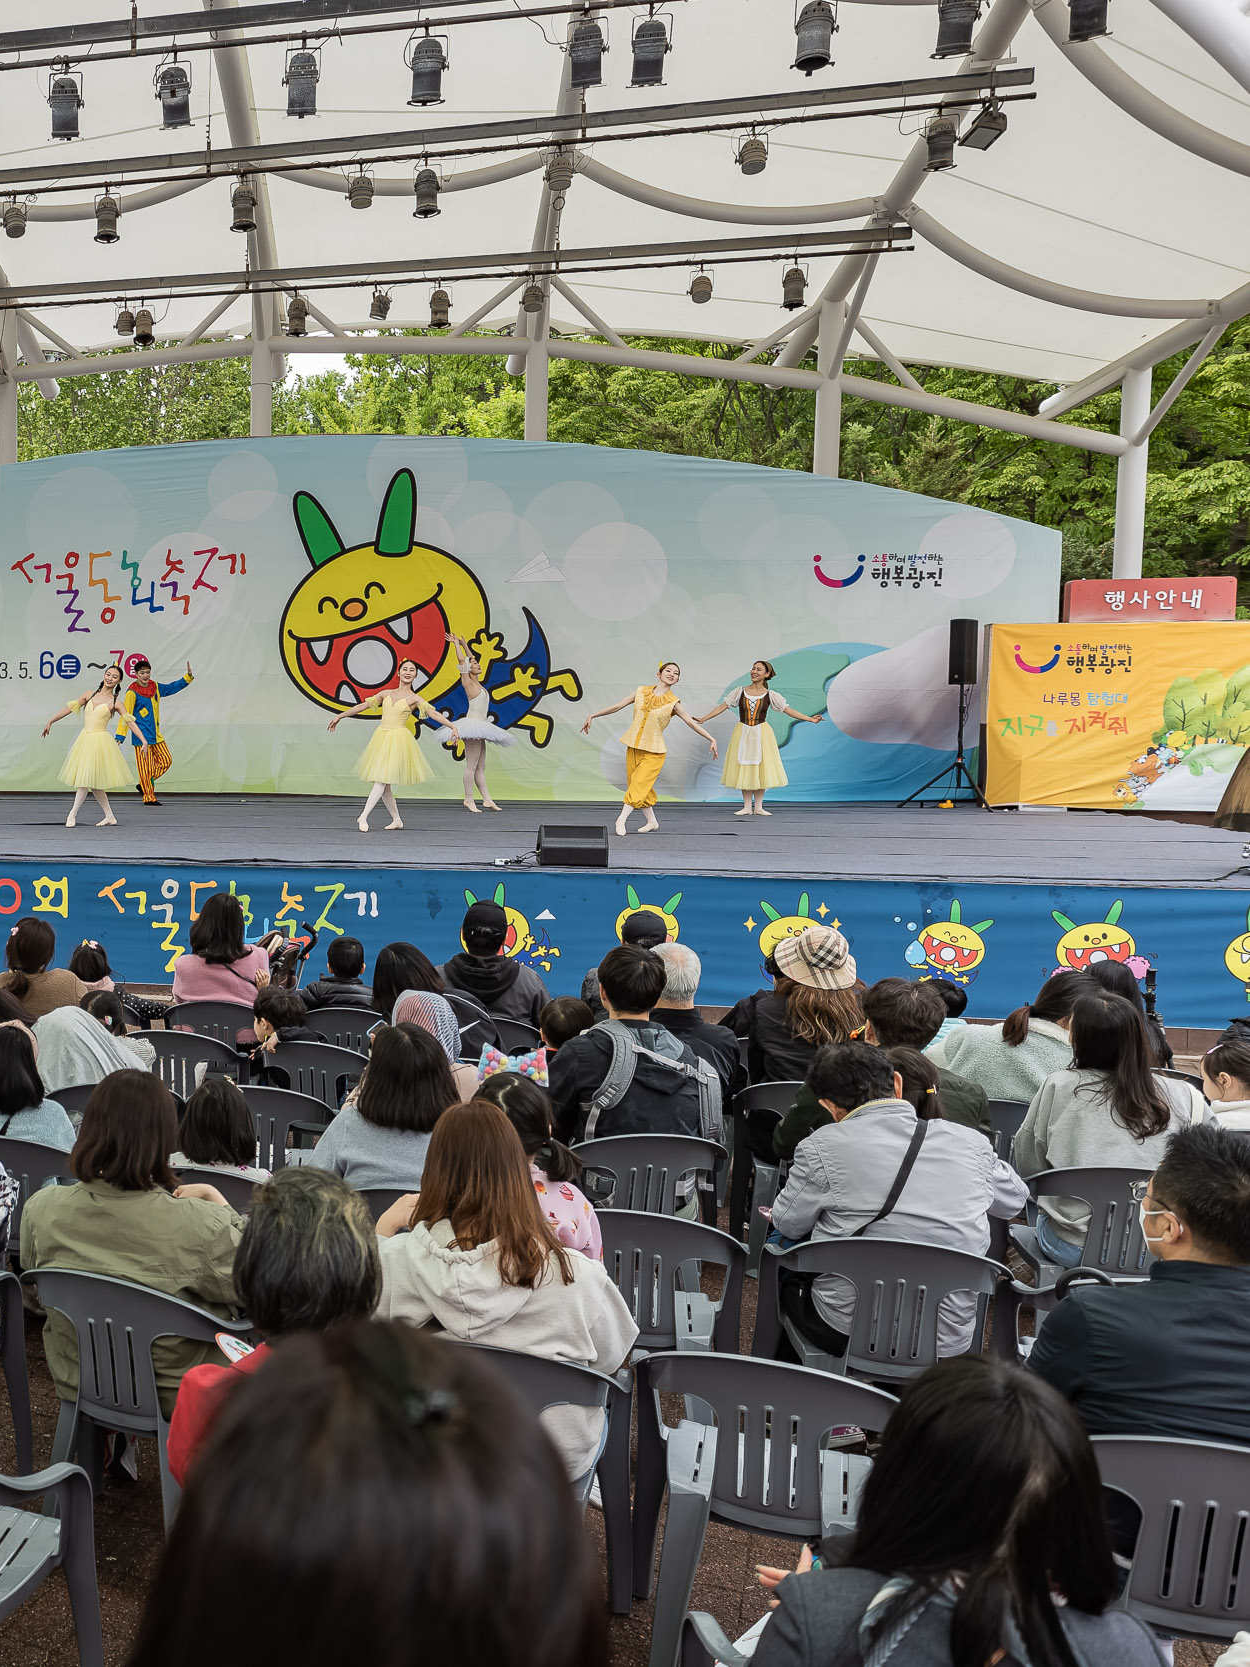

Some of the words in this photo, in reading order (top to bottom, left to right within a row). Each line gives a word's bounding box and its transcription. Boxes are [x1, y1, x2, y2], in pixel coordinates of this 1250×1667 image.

[871, 553, 906, 567] 소통하며
[907, 553, 944, 567] 발전하는
[871, 565, 943, 589] 행복광진
[1103, 588, 1203, 611] 행사안내
[1066, 643, 1098, 655] 소통하며
[1099, 643, 1133, 655] 발전하는
[18, 661, 33, 680] 5.
[1066, 654, 1133, 675] 행복광진
[1042, 692, 1081, 707] 나루몽
[1087, 691, 1129, 706] 탐험대
[997, 713, 1059, 737] 지구를
[1064, 710, 1129, 736] 지켜줘
[98, 877, 379, 973] 서울화축제
